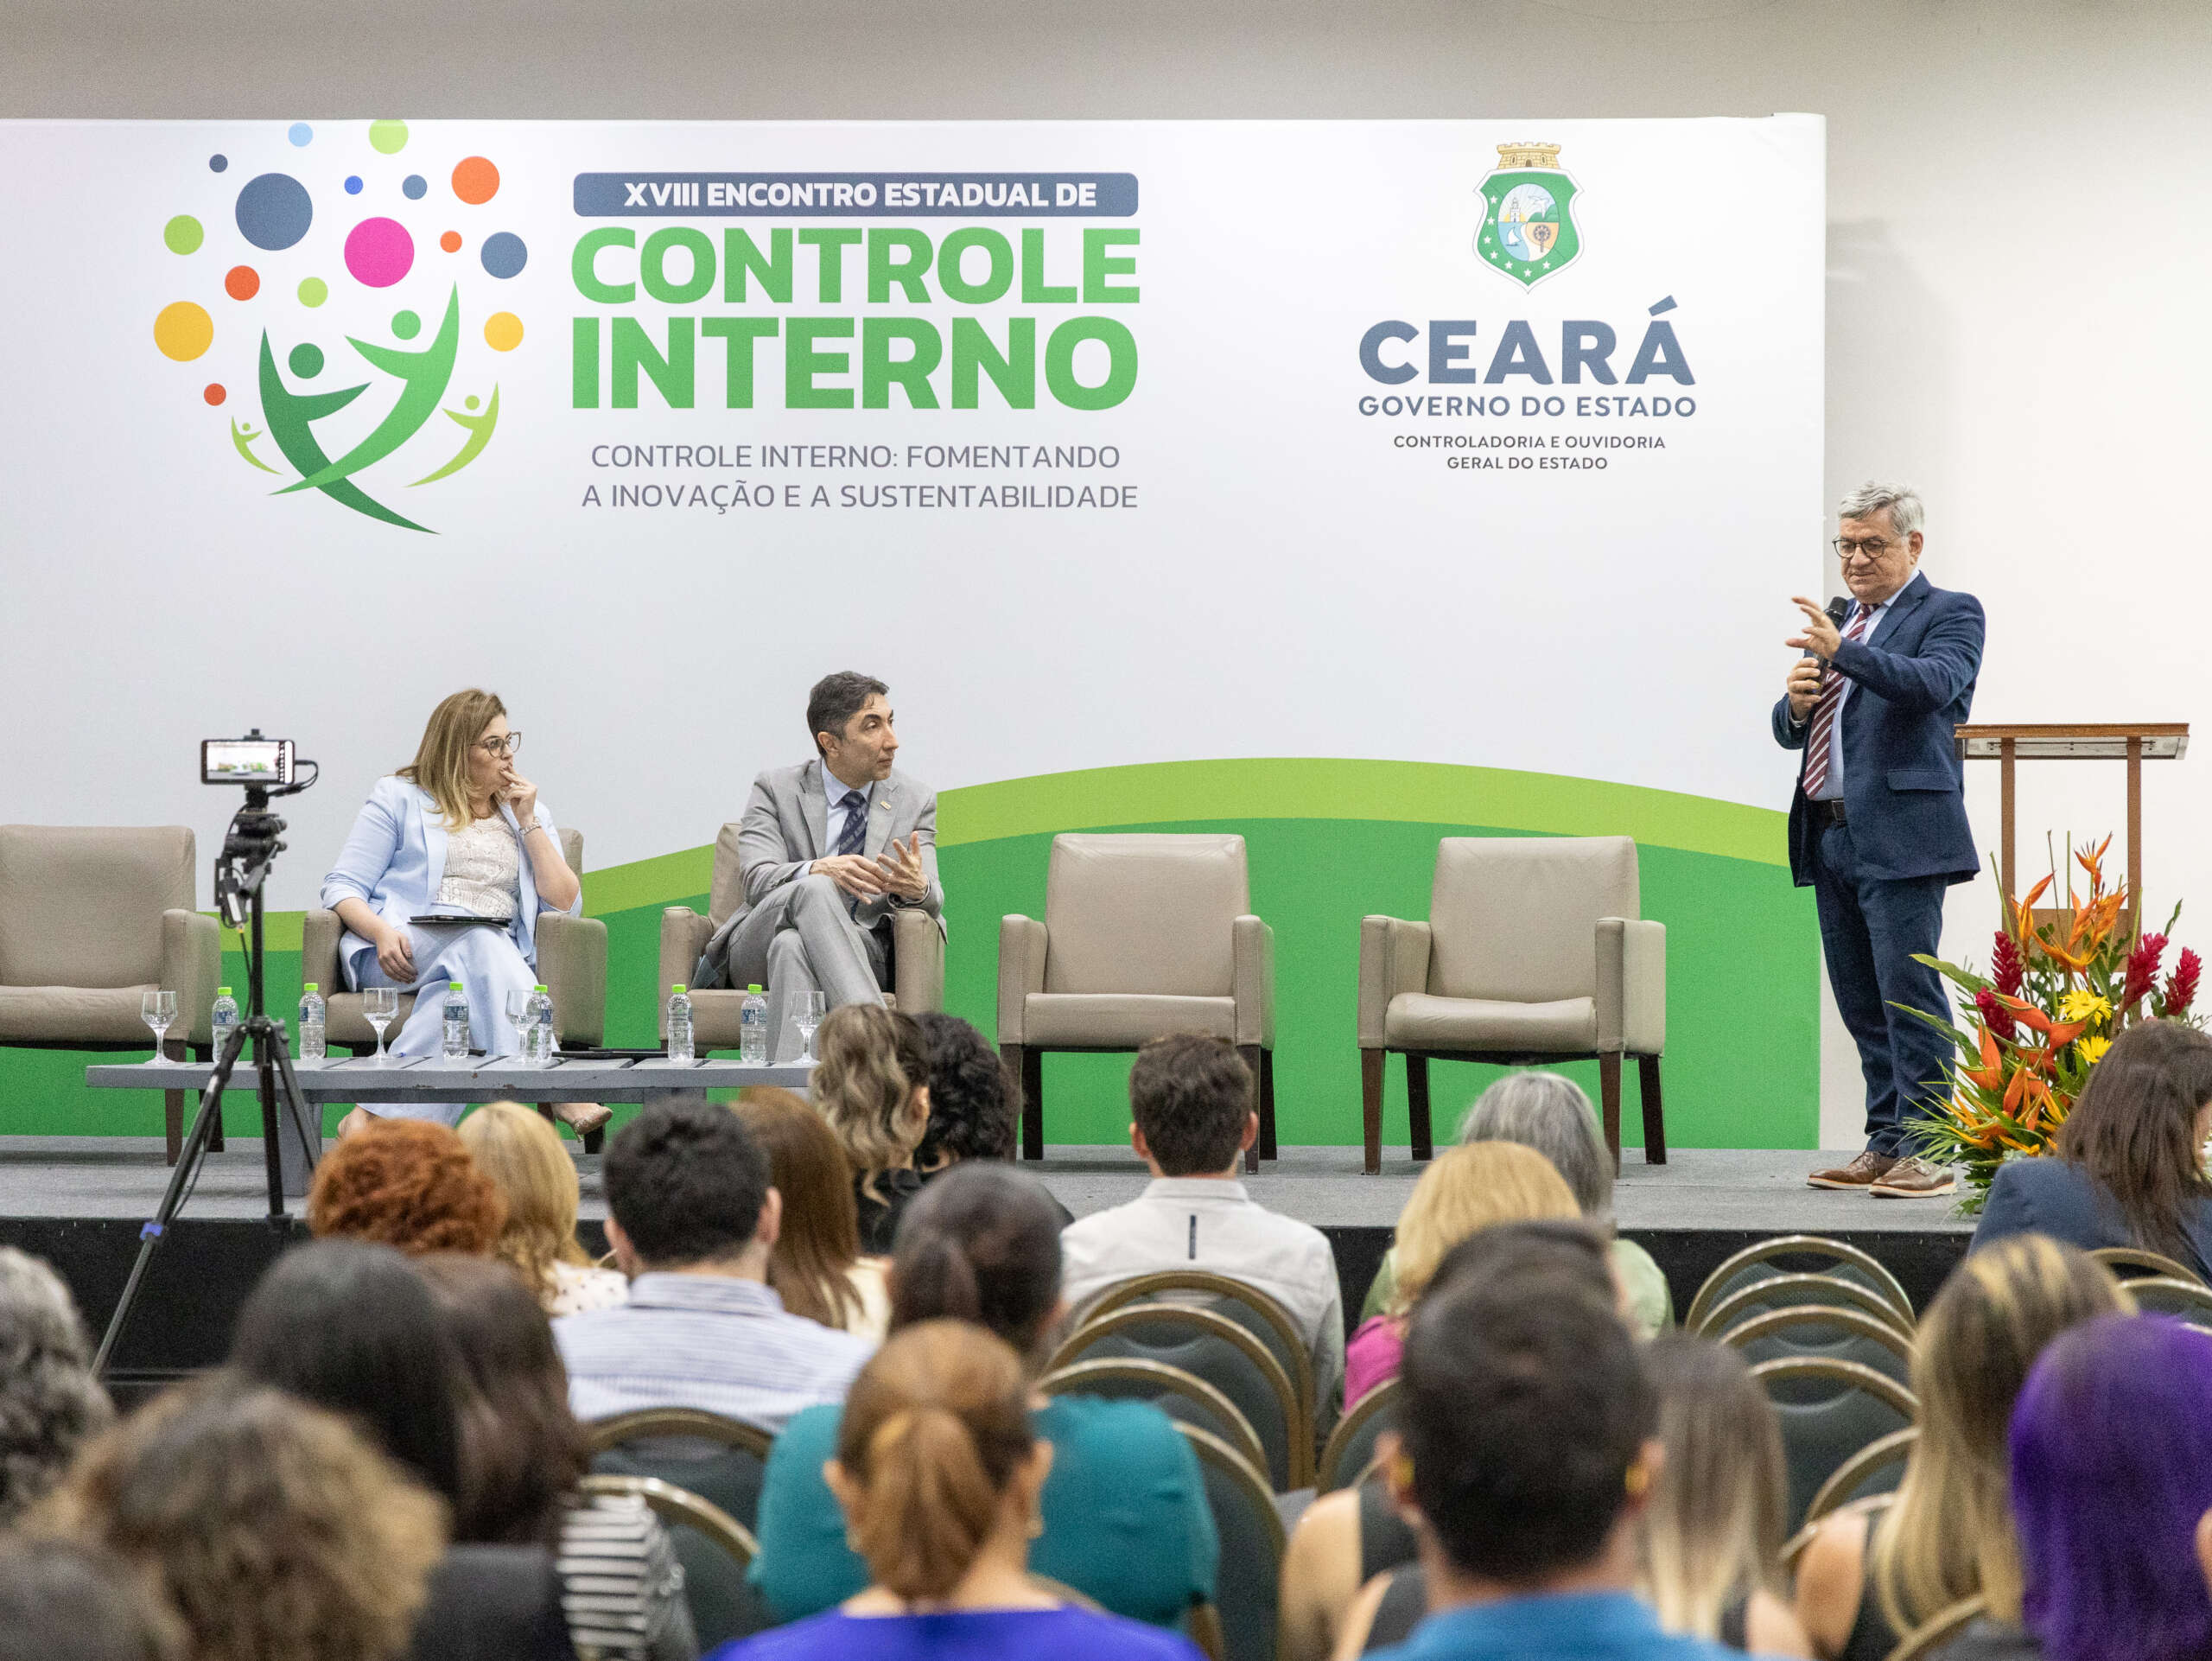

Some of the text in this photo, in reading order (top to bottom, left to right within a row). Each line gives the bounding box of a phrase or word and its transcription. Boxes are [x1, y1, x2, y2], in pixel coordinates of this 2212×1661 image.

[624, 182, 1096, 207] XVIII ENCONTRO ESTADUAL DE
[571, 226, 1141, 305] CONTROLE
[1358, 295, 1696, 386] CEARÁ
[572, 315, 1139, 411] INTERNO
[1358, 395, 1696, 417] GOVERNO DO ESTADO
[1394, 435, 1666, 449] CONTROLADORIA E OUVIDORIA
[591, 444, 1120, 468] CONTROLE INTERNO: FOMENTANDO
[1446, 456, 1608, 470] GERAL DO ESTADO
[582, 479, 1138, 515] A INOVAÇÃO E A SUSTENTABILIDADE
